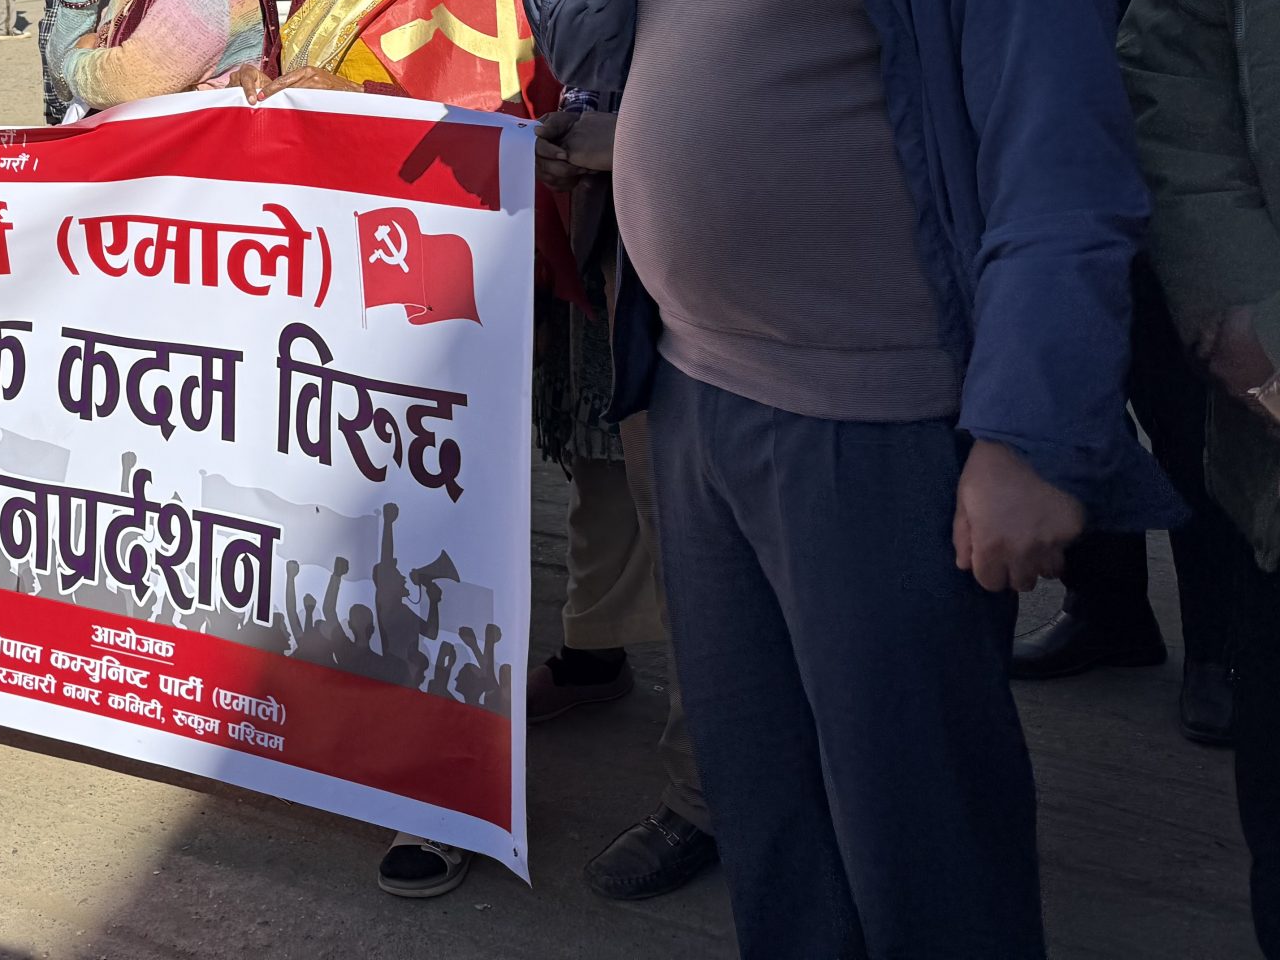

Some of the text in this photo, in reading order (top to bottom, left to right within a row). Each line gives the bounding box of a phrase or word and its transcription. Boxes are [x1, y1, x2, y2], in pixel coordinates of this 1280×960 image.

[56, 203, 333, 308] (एमाले)
[57, 326, 244, 443] कदम
[91, 624, 176, 658] आयोजक
[50, 648, 151, 690] कम्युनिष्ट
[158, 673, 204, 703] पार्टी
[212, 686, 287, 725] (एमाले)
[62, 682, 103, 706] नगर
[107, 690, 165, 724] कमिटी,
[227, 721, 285, 752] पश्चिम
